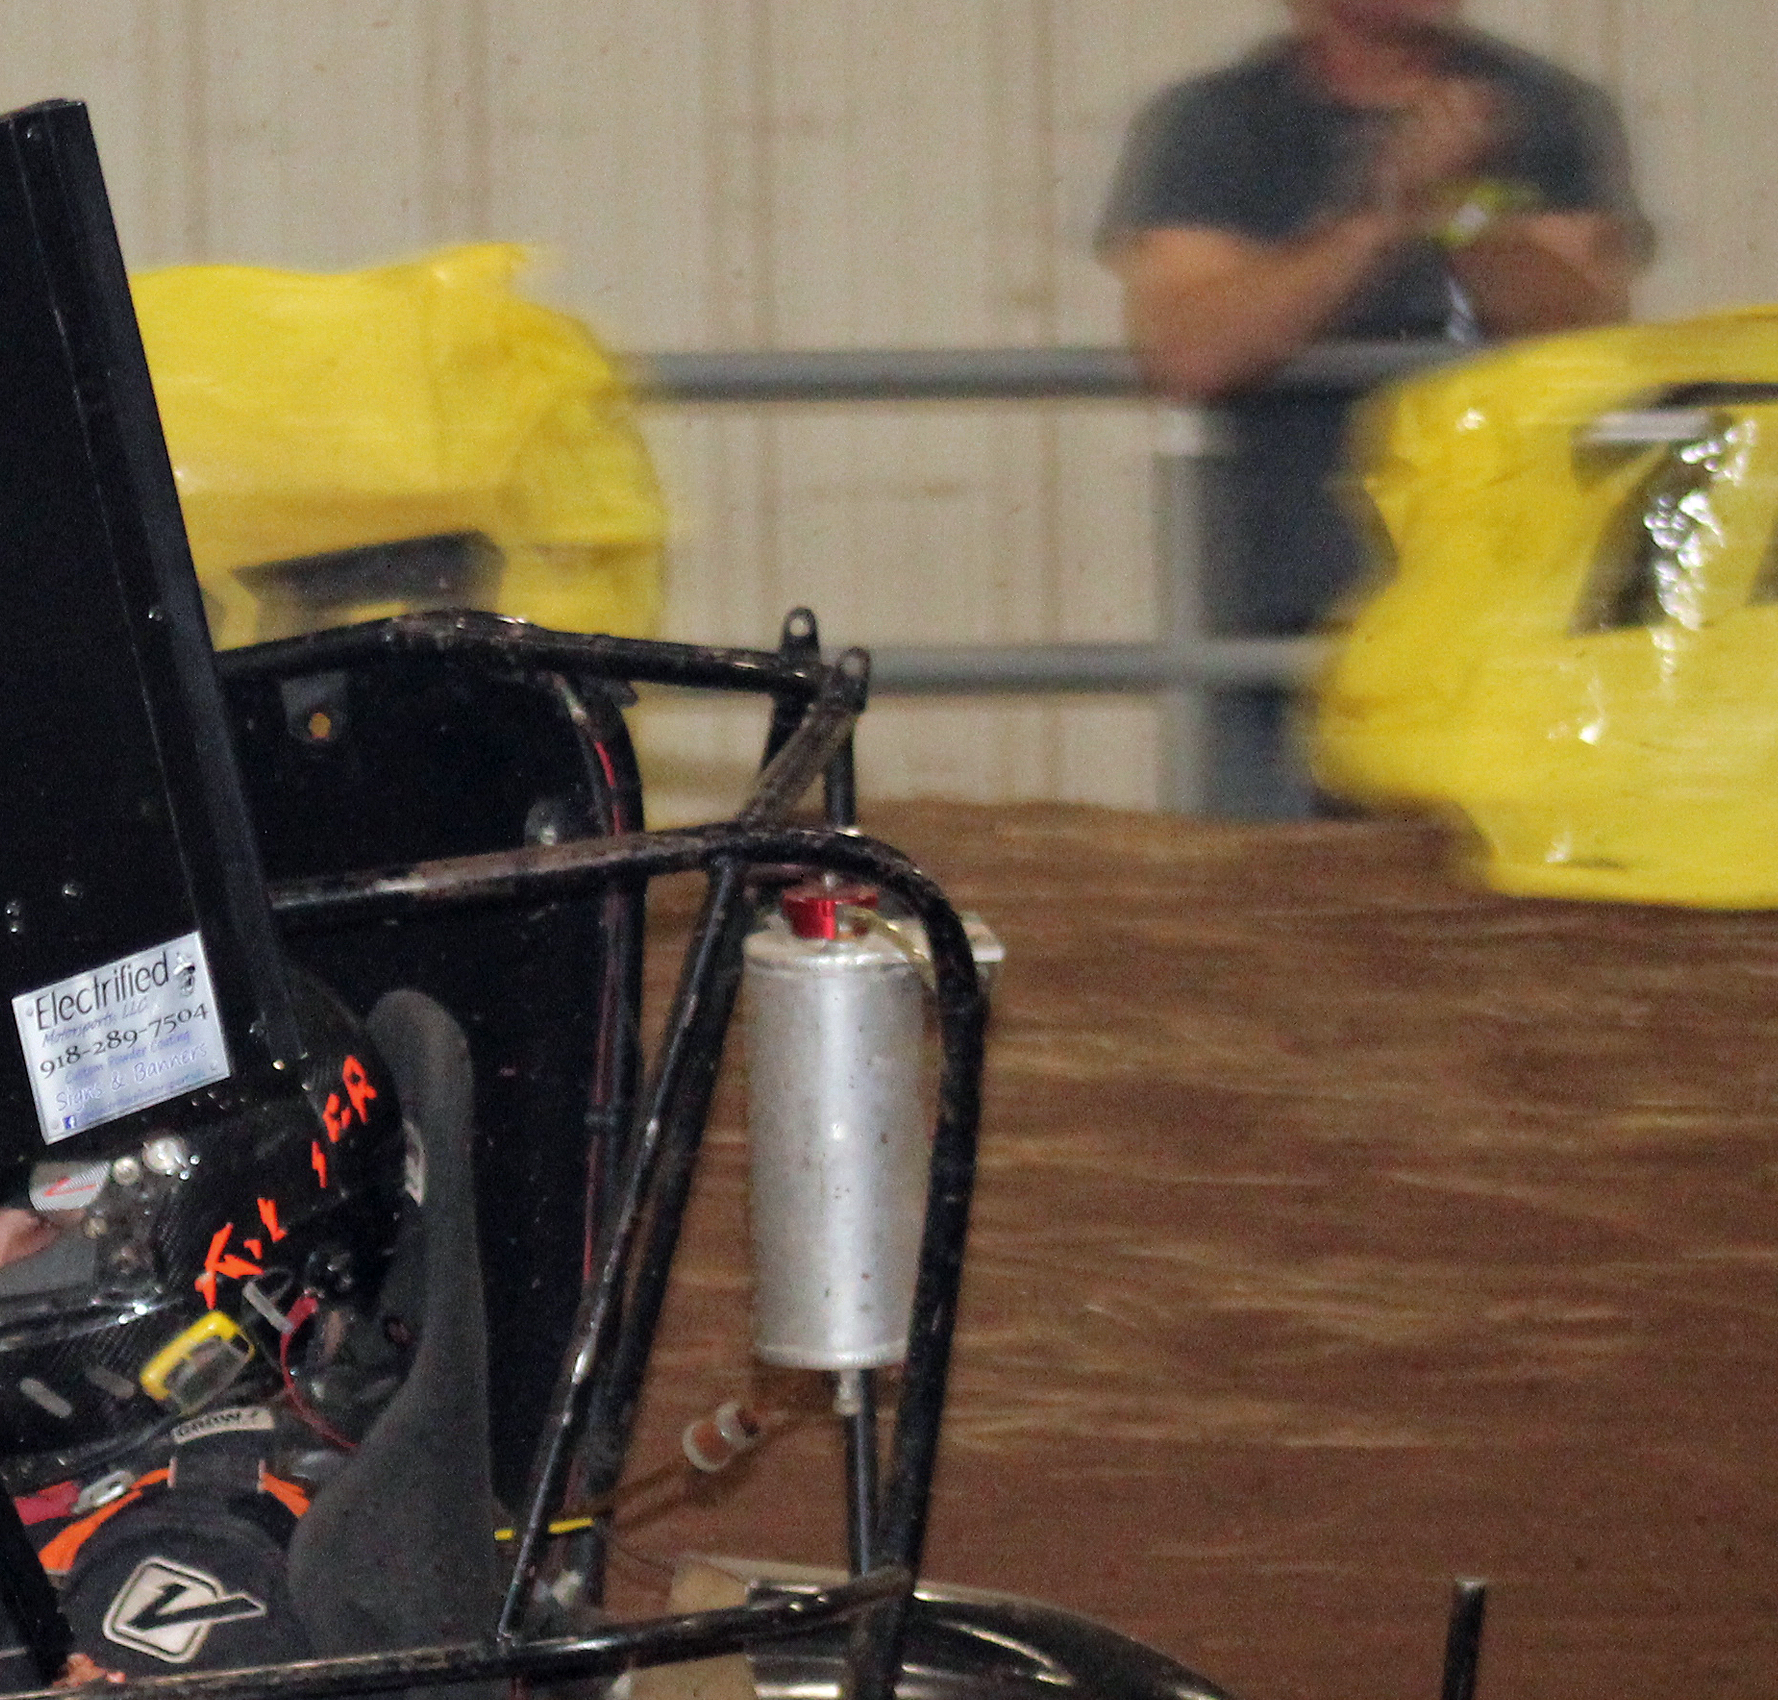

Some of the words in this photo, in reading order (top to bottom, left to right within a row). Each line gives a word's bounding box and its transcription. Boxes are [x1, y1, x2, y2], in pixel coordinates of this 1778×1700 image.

[34, 950, 170, 1032] Electrified
[39, 1003, 209, 1080] 918-289-7504
[133, 1041, 208, 1083] Banners
